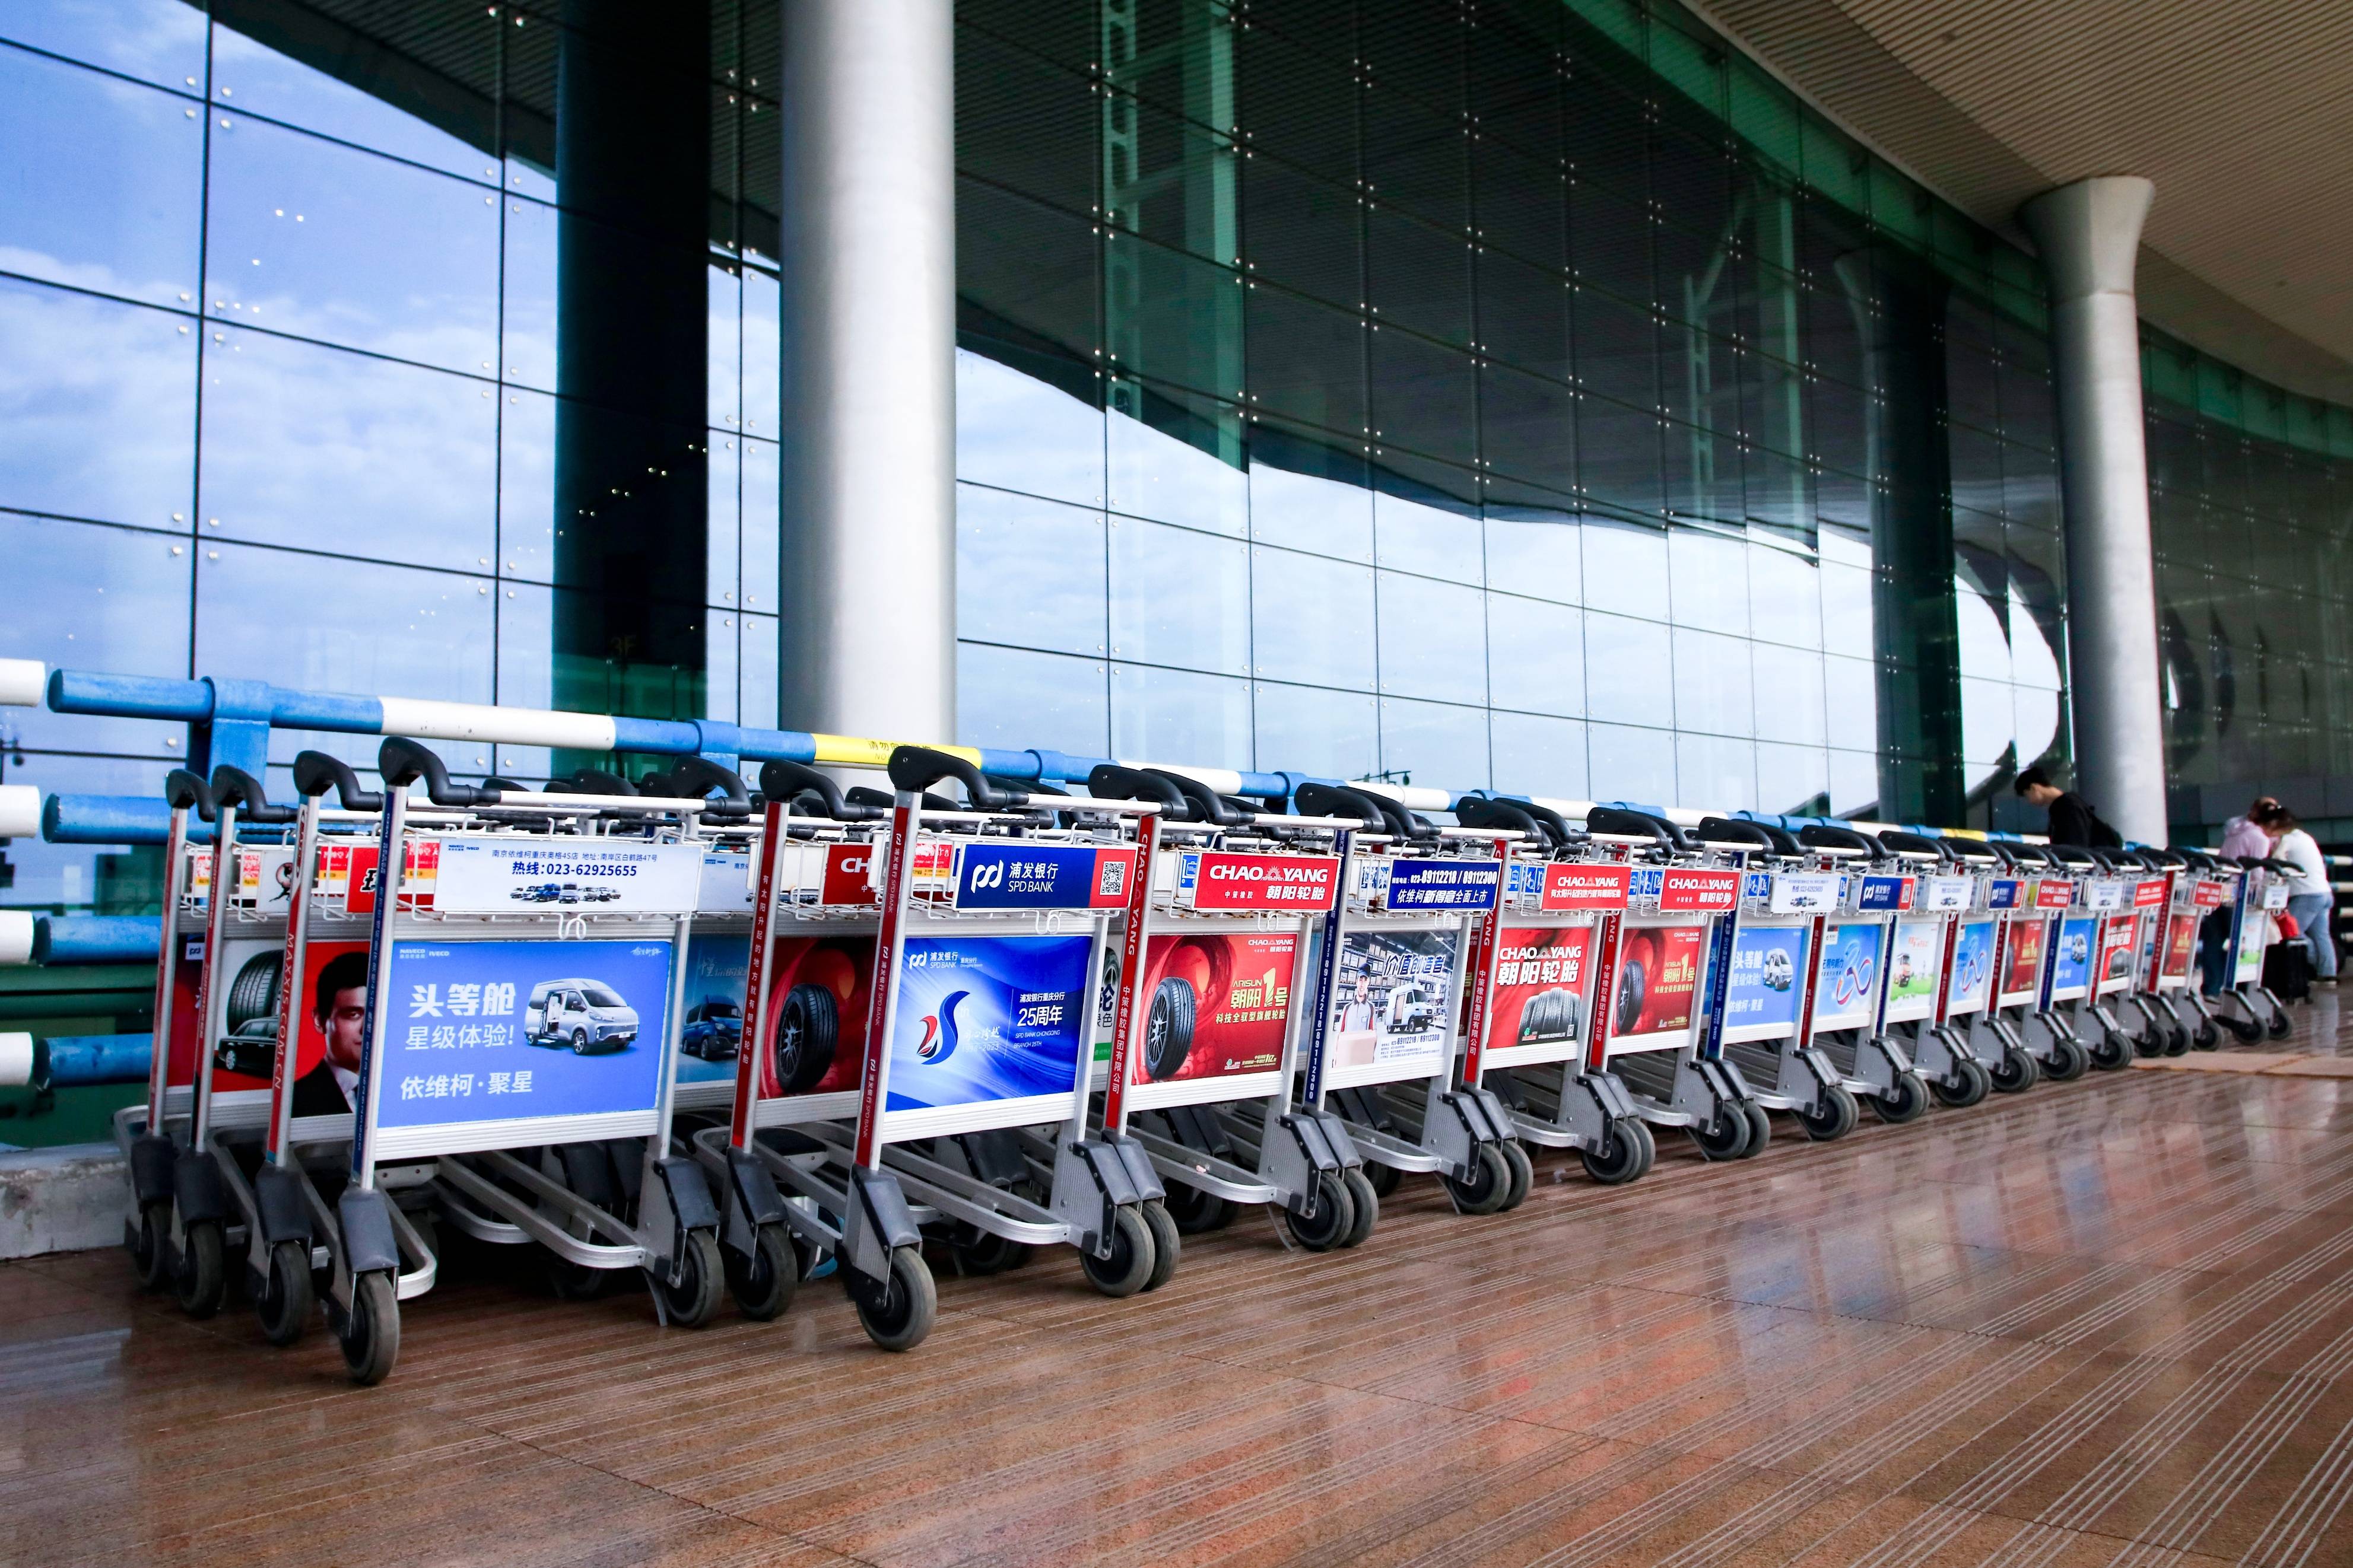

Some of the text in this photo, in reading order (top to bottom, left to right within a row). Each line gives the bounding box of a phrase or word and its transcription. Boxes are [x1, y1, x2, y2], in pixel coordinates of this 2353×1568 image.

[512, 861, 637, 877] 热线：023-62925655
[1008, 861, 1059, 879] 浦发银行
[1209, 865, 1264, 881] CHAO
[1282, 867, 1328, 883] YANG
[1462, 870, 1498, 885] 89112300
[1008, 881, 1054, 892] SPD BANK
[1557, 876, 1619, 887] CHAO YANG
[1669, 878, 1733, 890] CHAO YANG
[1128, 834, 1149, 956] CHAO YANG
[1224, 885, 1326, 901] 中策橡胶 朝阳轮胎
[1396, 889, 1488, 904] 依维柯新得意全面上市
[1699, 892, 1732, 903] 朝阳轮胎
[930, 952, 958, 961] 浦发银行
[1499, 946, 1582, 960] CHAO YANG
[742, 875, 770, 1064] 有太阳升起的地方就有朝阳轮胎
[1383, 953, 1446, 977] 价值创造者
[1497, 959, 1580, 986] 朝阳轮胎
[1230, 967, 1288, 1009] 朝阳1号
[409, 982, 516, 1018] 头等舱
[1020, 992, 1065, 1003] 浦发银行重庆分行
[275, 933, 295, 1089] MAXXIS.COM.CN
[1017, 1005, 1063, 1027] 25周年
[1469, 969, 1487, 1056] 中策橡胶集团有限公司
[405, 1023, 513, 1050] 星级体验!
[1113, 985, 1130, 1095] 中策橡胶集团有限公司
[401, 1070, 532, 1100] 依维柯·聚星
